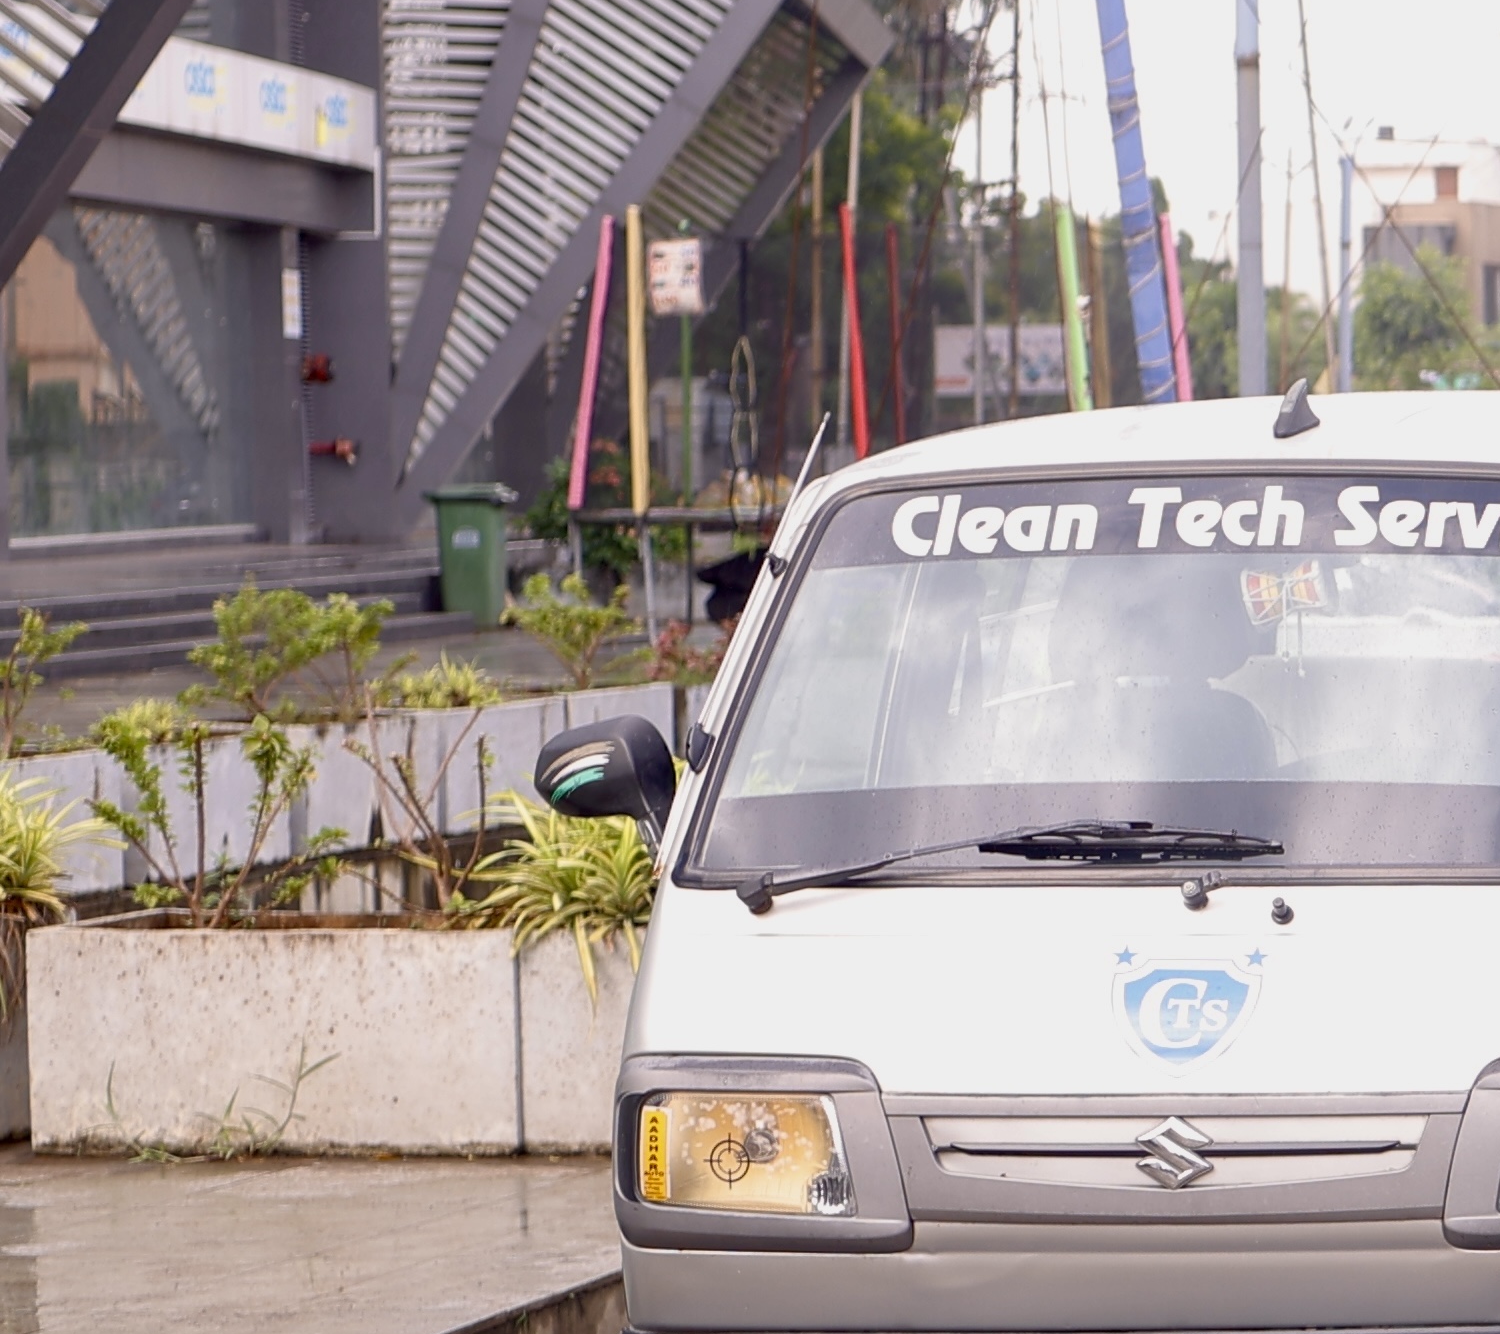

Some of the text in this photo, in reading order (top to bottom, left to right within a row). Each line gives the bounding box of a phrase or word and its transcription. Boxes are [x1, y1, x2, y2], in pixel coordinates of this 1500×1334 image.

[891, 494, 1098, 557] Clean
[1128, 485, 1304, 547] Tech
[1138, 977, 1229, 1049] CTS
[649, 1115, 659, 1171] AADHAR
